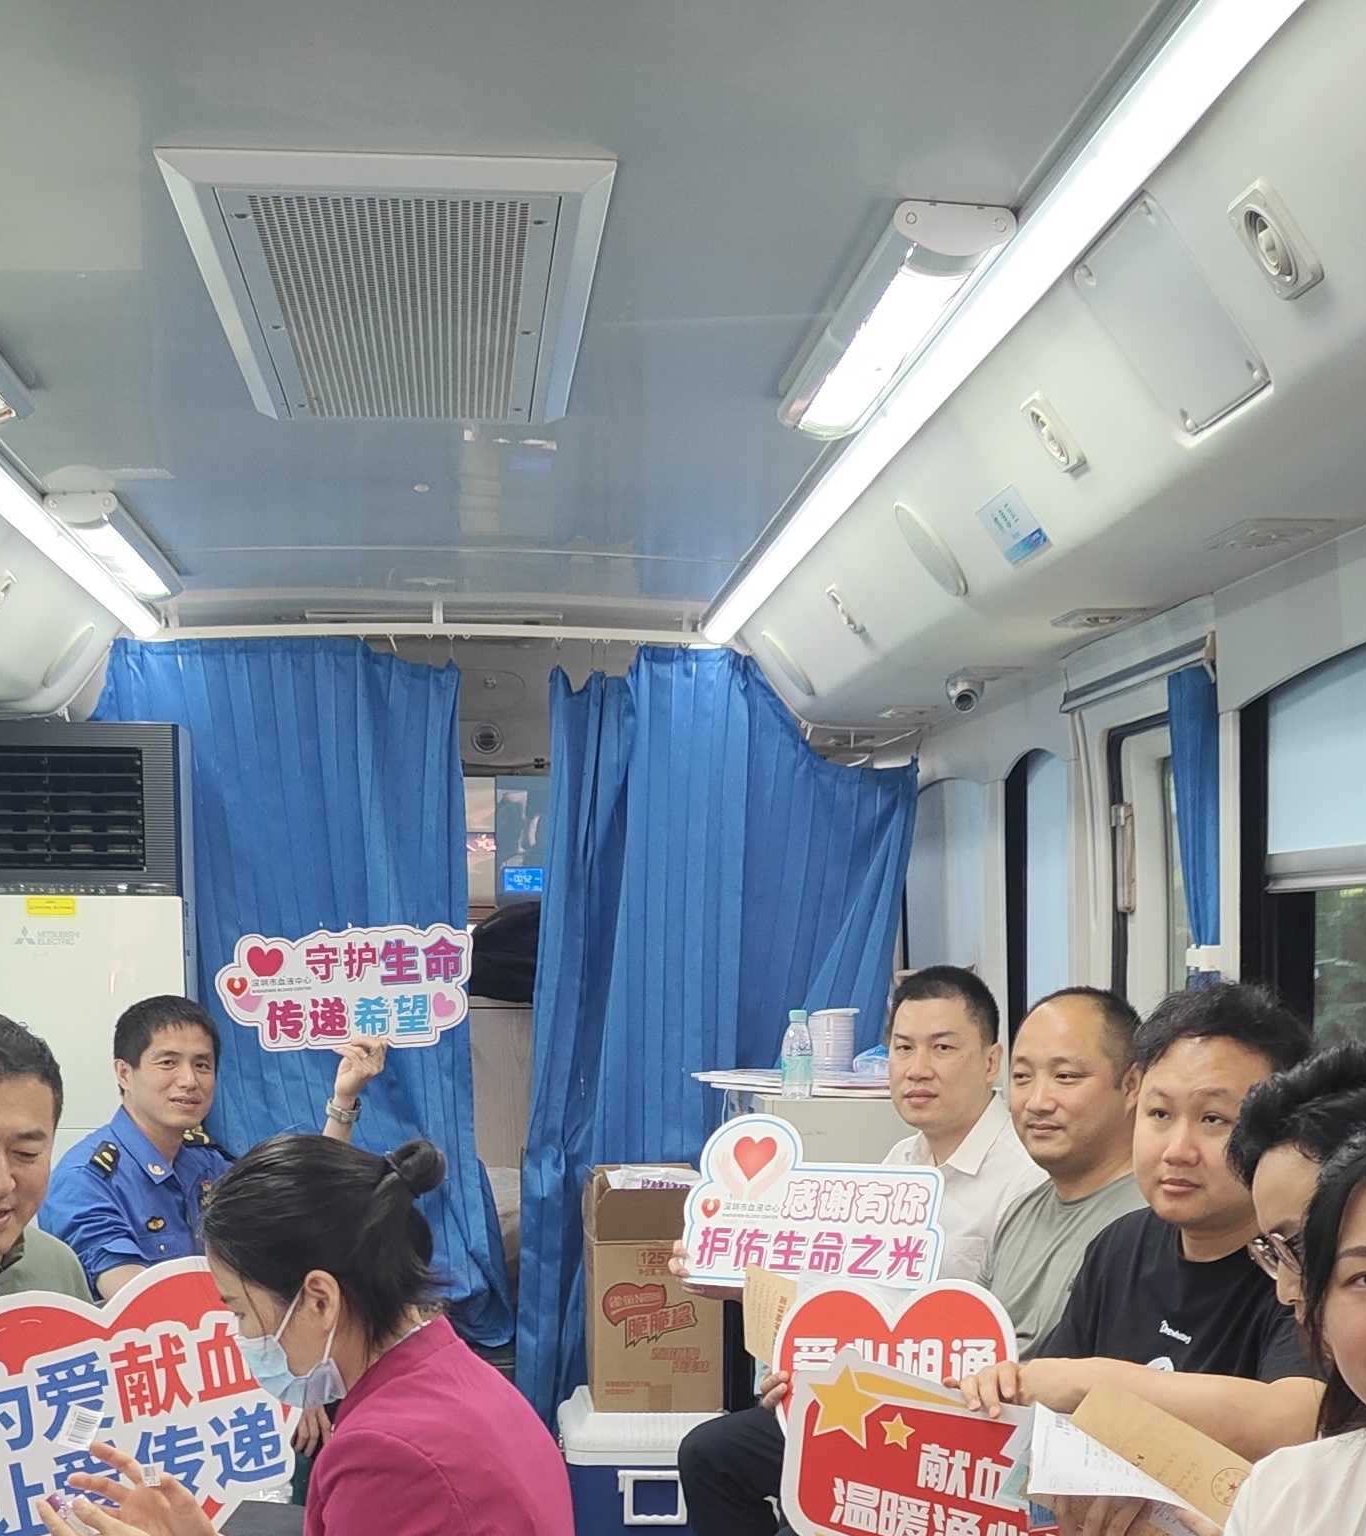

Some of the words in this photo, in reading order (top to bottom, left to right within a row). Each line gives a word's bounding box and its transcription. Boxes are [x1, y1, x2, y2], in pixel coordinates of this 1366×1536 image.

[37, 931, 81, 939] MITSUBISHI
[37, 938, 75, 946] ELECTRIC
[304, 935, 466, 985] 守护生命
[266, 994, 432, 1043] 传递希望
[781, 1179, 932, 1226] 感谢有你
[695, 1226, 928, 1279] 护佑生命之光
